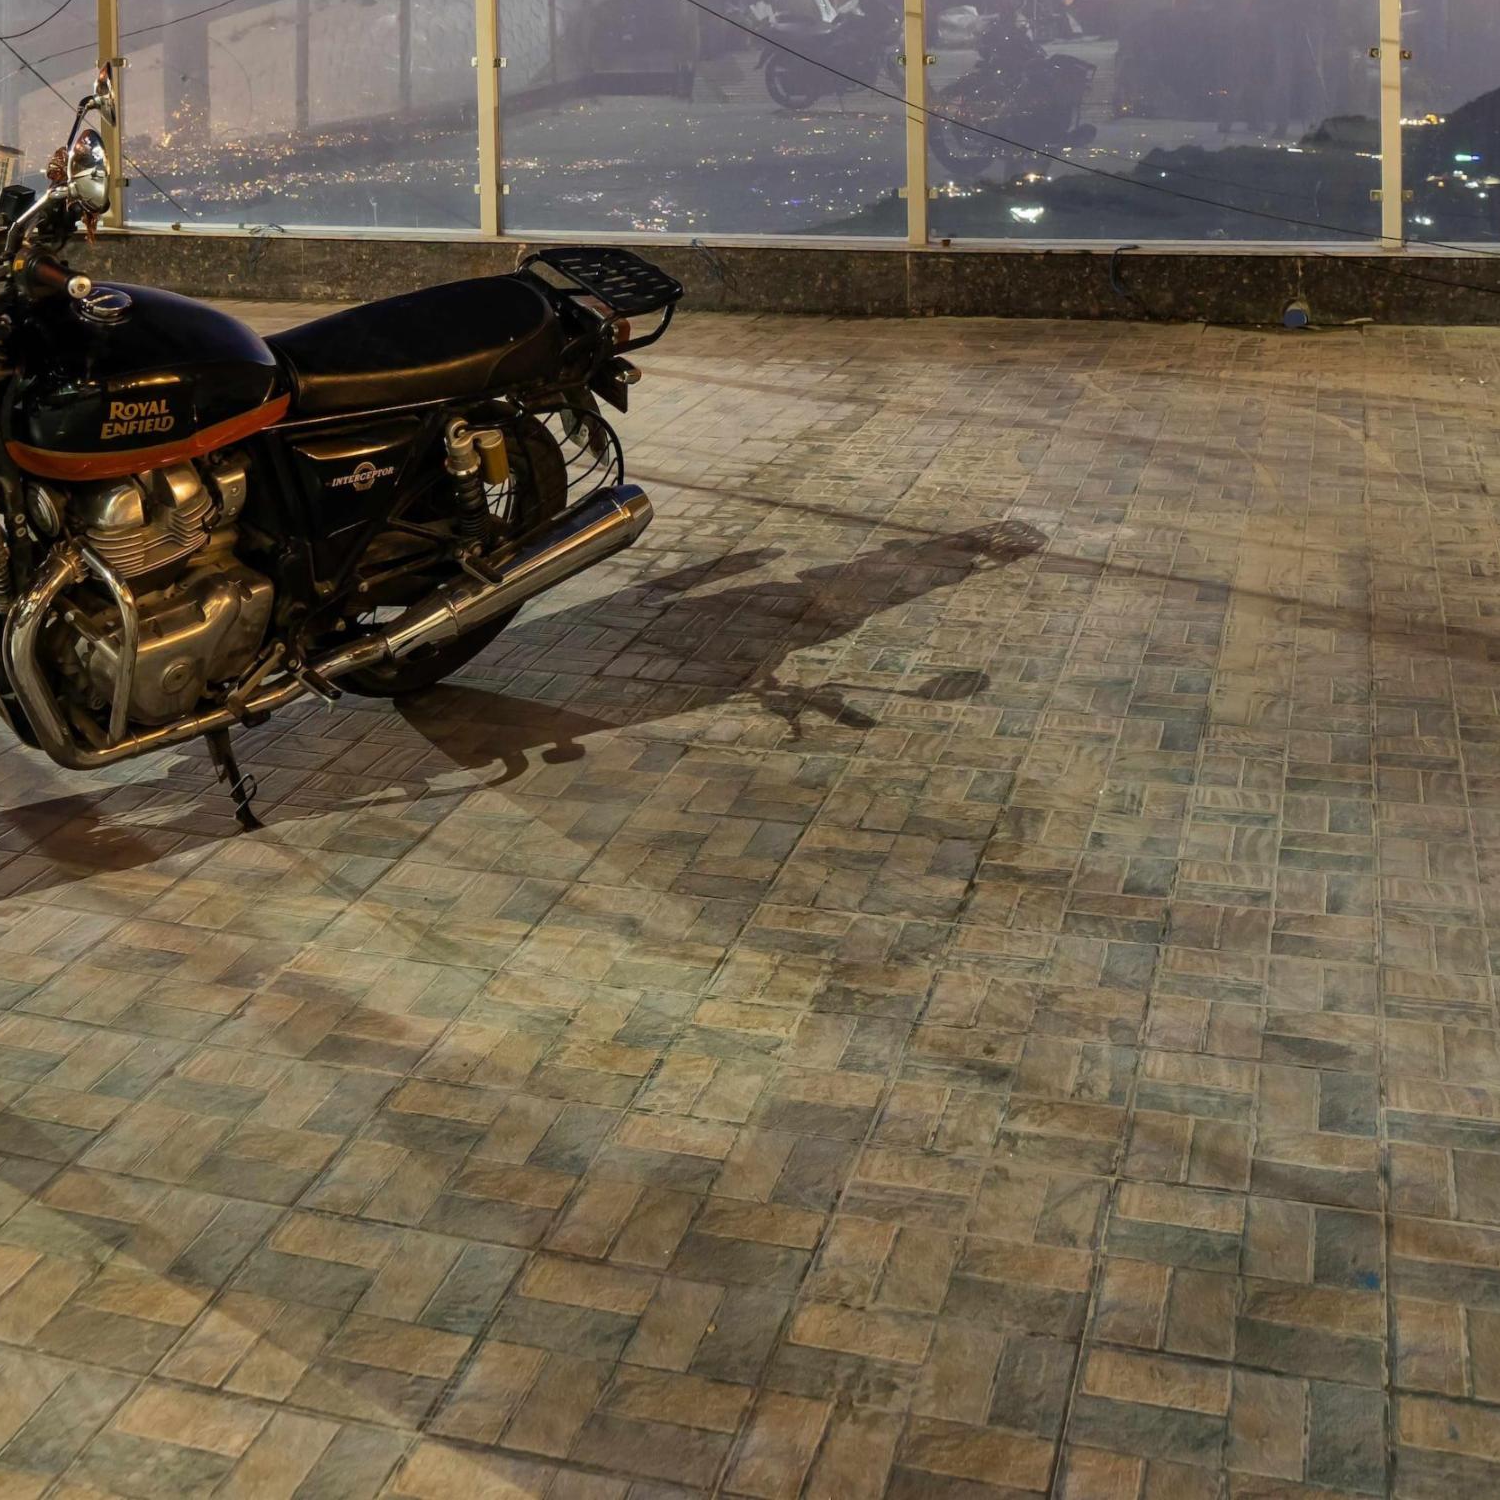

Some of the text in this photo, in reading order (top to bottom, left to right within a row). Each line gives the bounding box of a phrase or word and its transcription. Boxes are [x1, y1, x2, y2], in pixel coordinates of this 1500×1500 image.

[109, 399, 170, 420] ROYAL
[100, 415, 175, 440] ENFIELD
[331, 466, 395, 488] INTERCEPTOR
